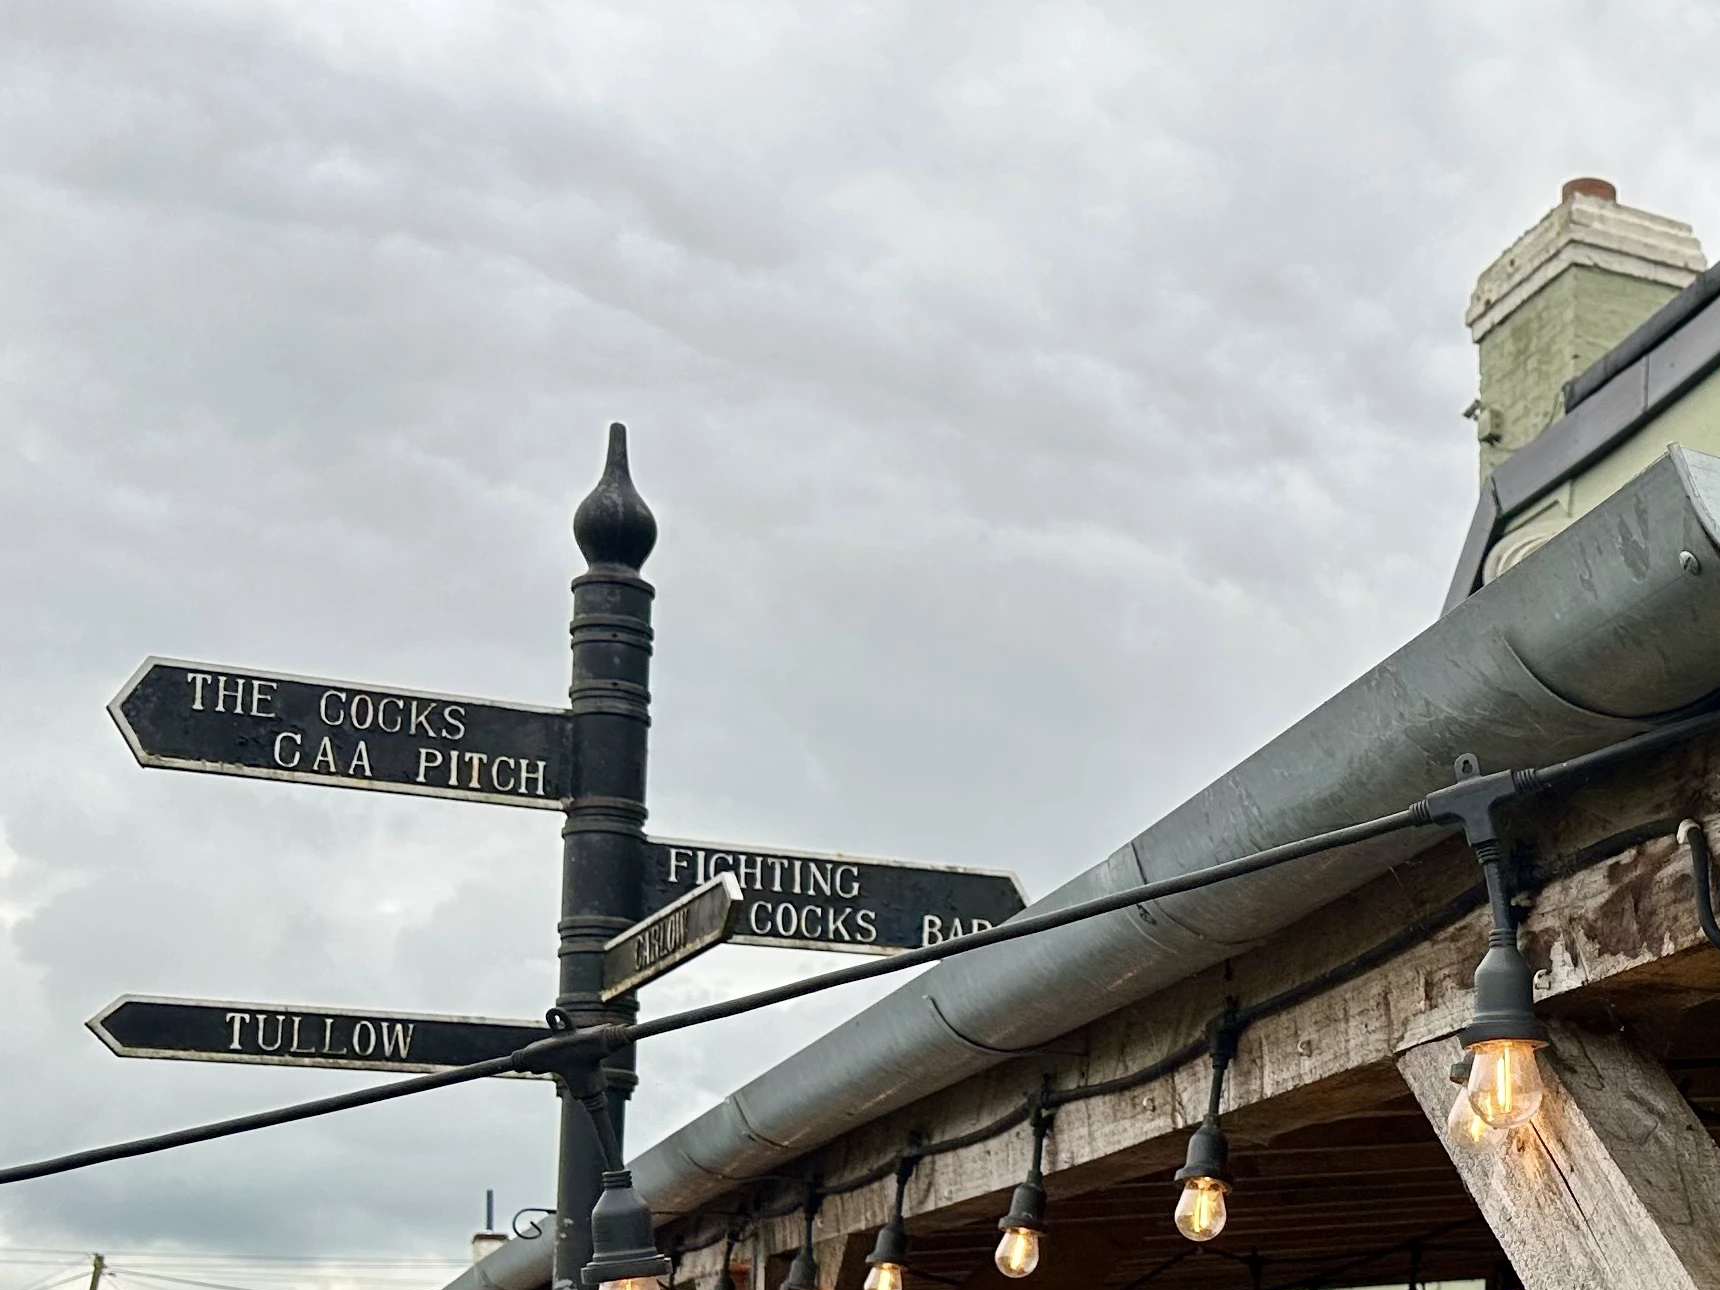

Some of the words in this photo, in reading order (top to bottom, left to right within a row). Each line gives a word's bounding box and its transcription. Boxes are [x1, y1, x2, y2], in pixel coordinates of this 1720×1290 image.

[187, 673, 277, 718] THE
[320, 690, 466, 740] COCKS
[416, 748, 547, 796] PITCH
[634, 908, 690, 970] CARLOW
[751, 901, 877, 943] COCKS
[226, 1012, 415, 1060] TULLOW
